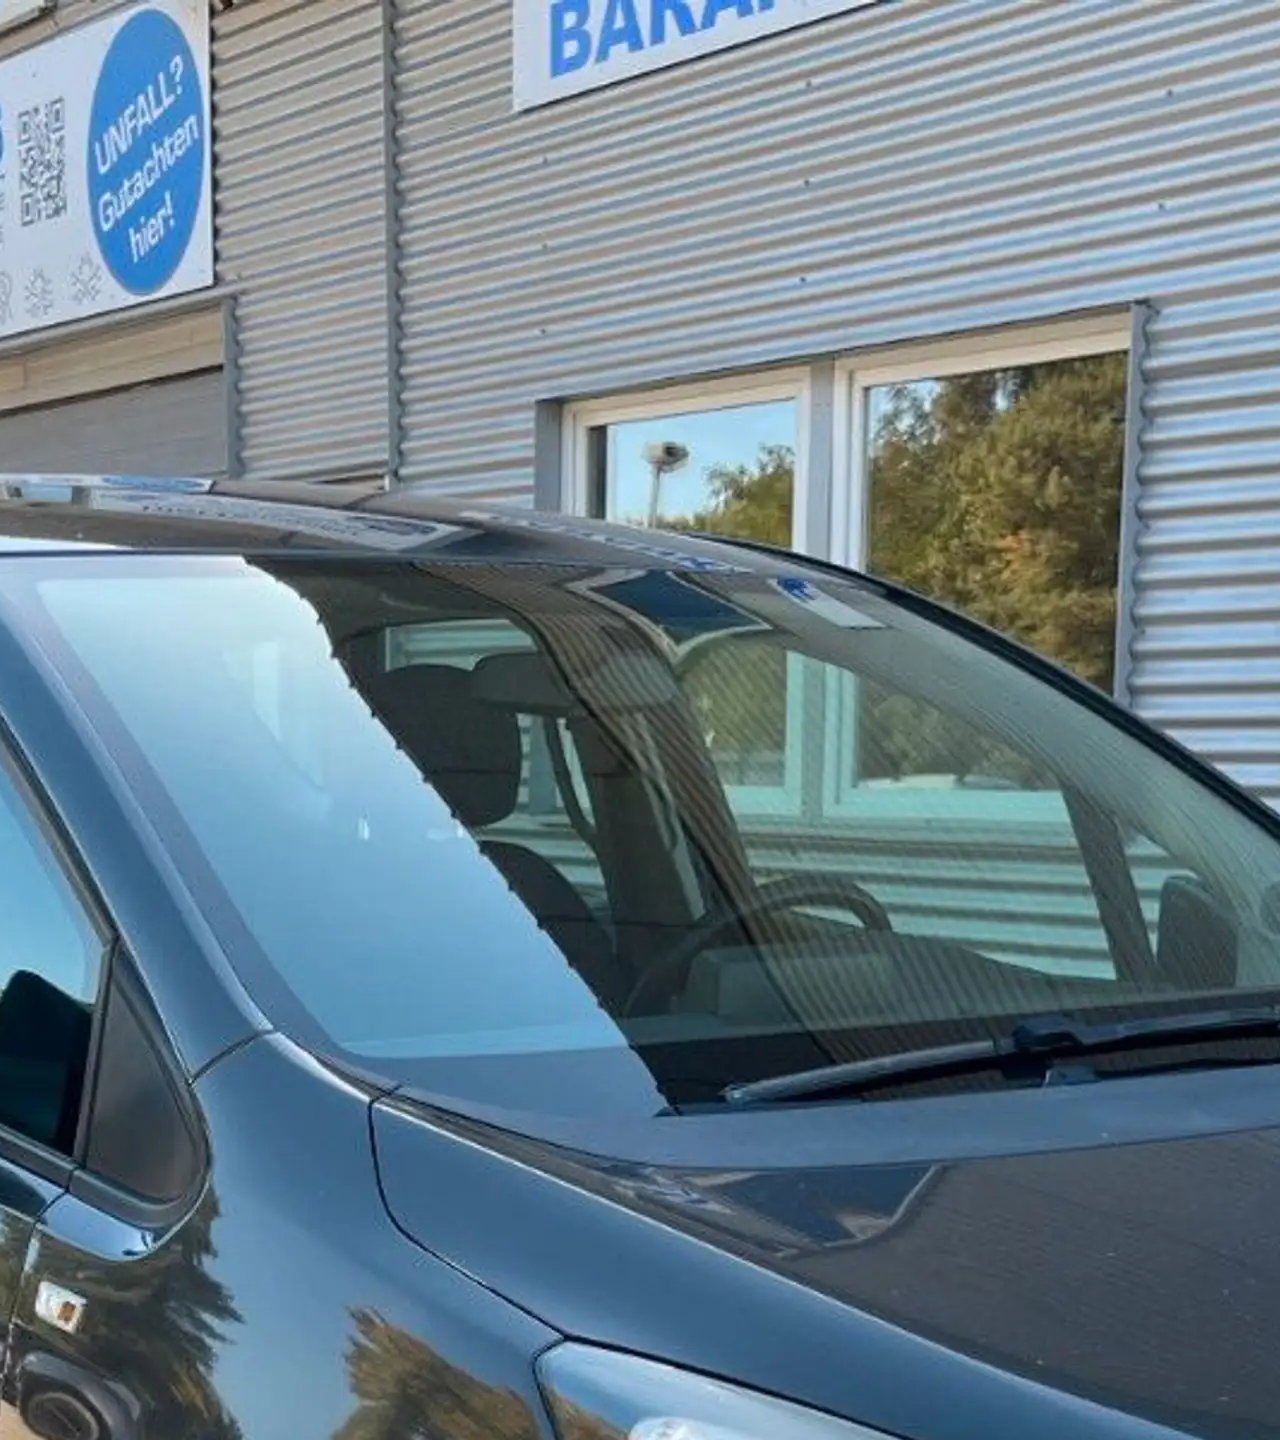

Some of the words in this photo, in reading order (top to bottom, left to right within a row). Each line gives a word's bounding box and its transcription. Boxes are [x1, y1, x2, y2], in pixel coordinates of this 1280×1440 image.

[550, 0, 775, 78] BAR
[95, 55, 184, 174] UNFALL?
[98, 114, 199, 232] Gutachten
[129, 189, 175, 263] hier!
